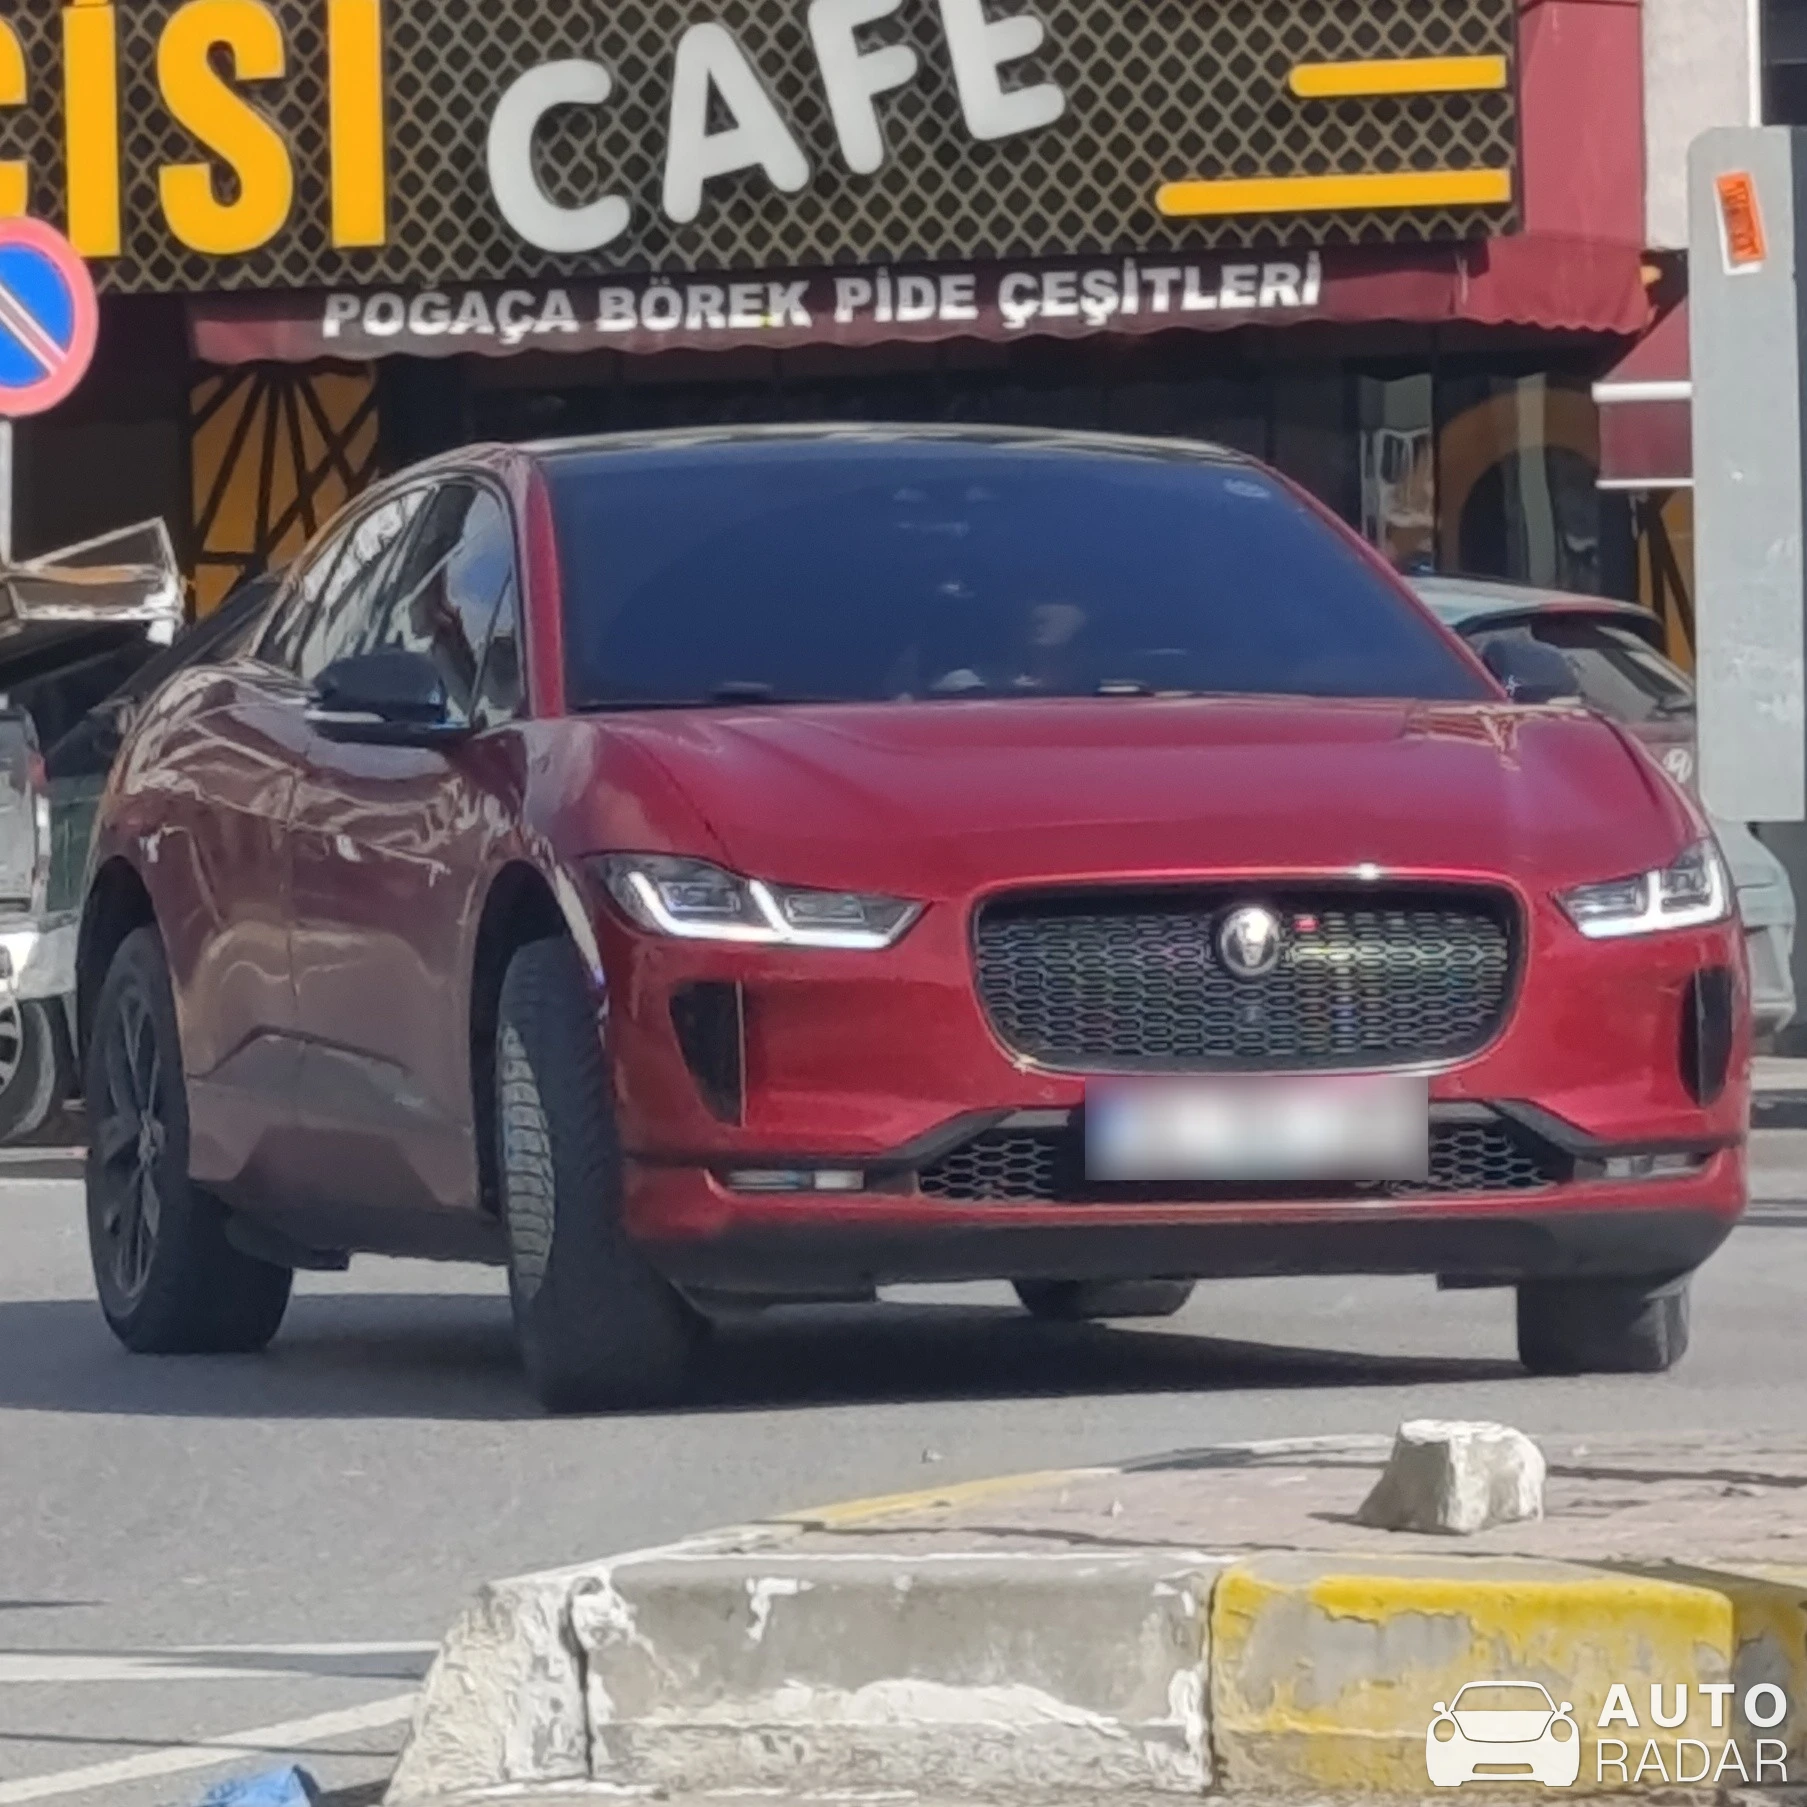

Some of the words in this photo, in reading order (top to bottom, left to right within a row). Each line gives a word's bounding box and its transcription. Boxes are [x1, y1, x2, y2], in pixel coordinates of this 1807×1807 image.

[596, 277, 812, 332] BÖREK
[833, 266, 978, 322] PİDE
[999, 250, 1321, 329] ÇEŞİTLERİ
